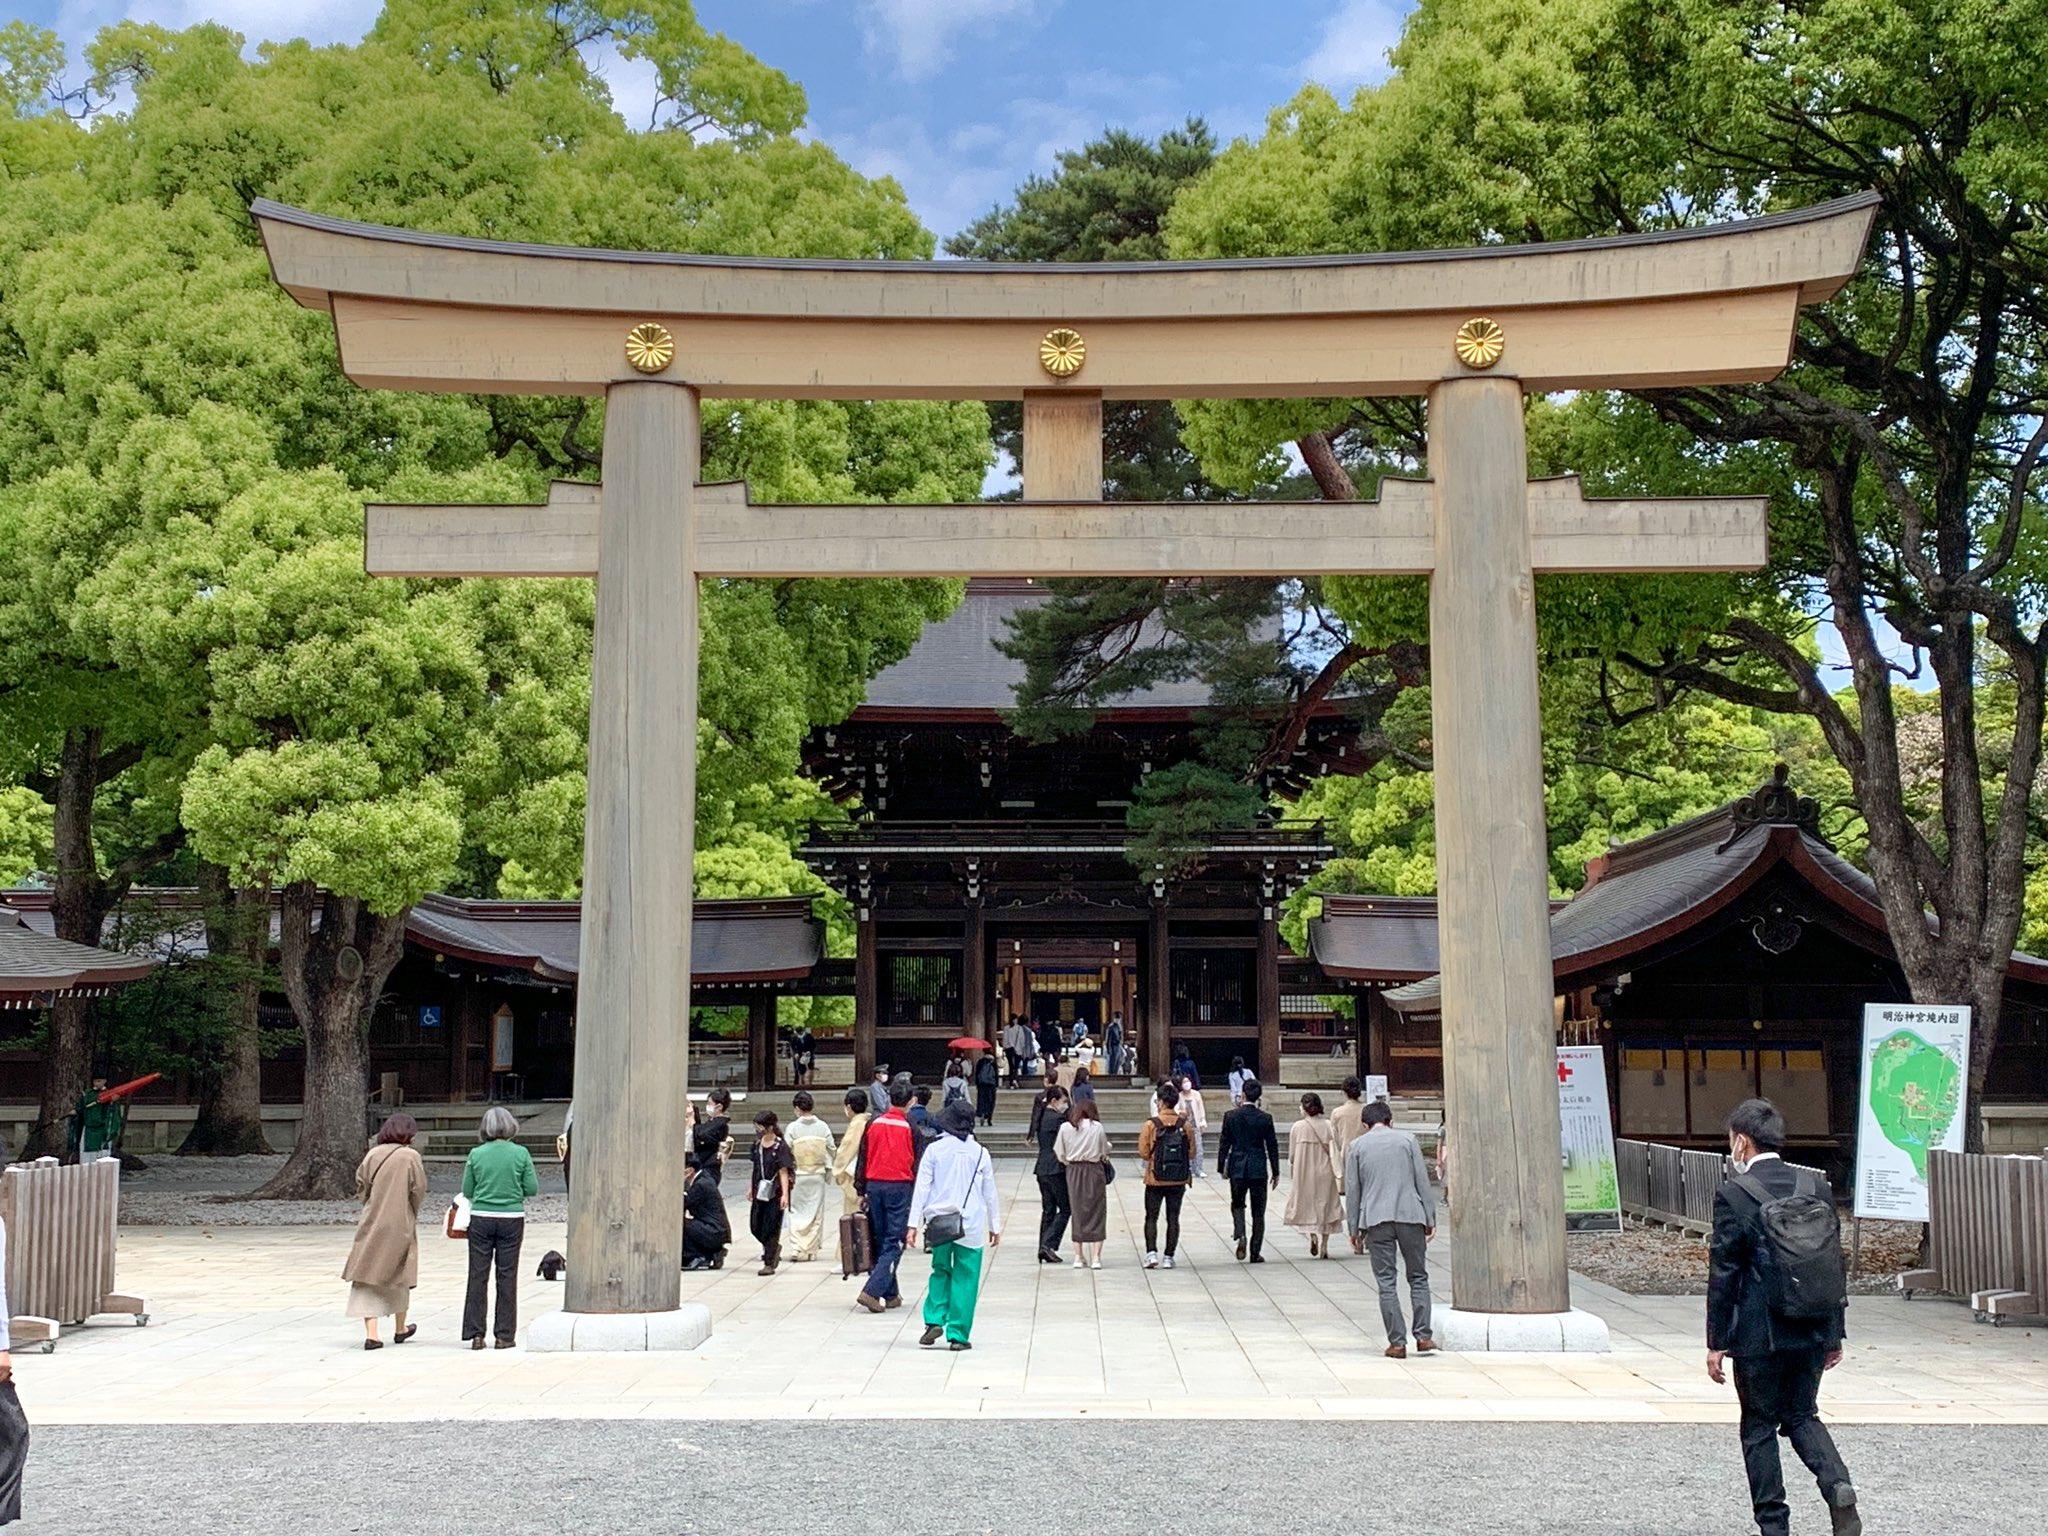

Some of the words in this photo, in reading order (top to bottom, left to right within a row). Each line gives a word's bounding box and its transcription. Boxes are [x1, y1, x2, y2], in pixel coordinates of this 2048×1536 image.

[1882, 1010, 1960, 1024] 明治神宮境内図
